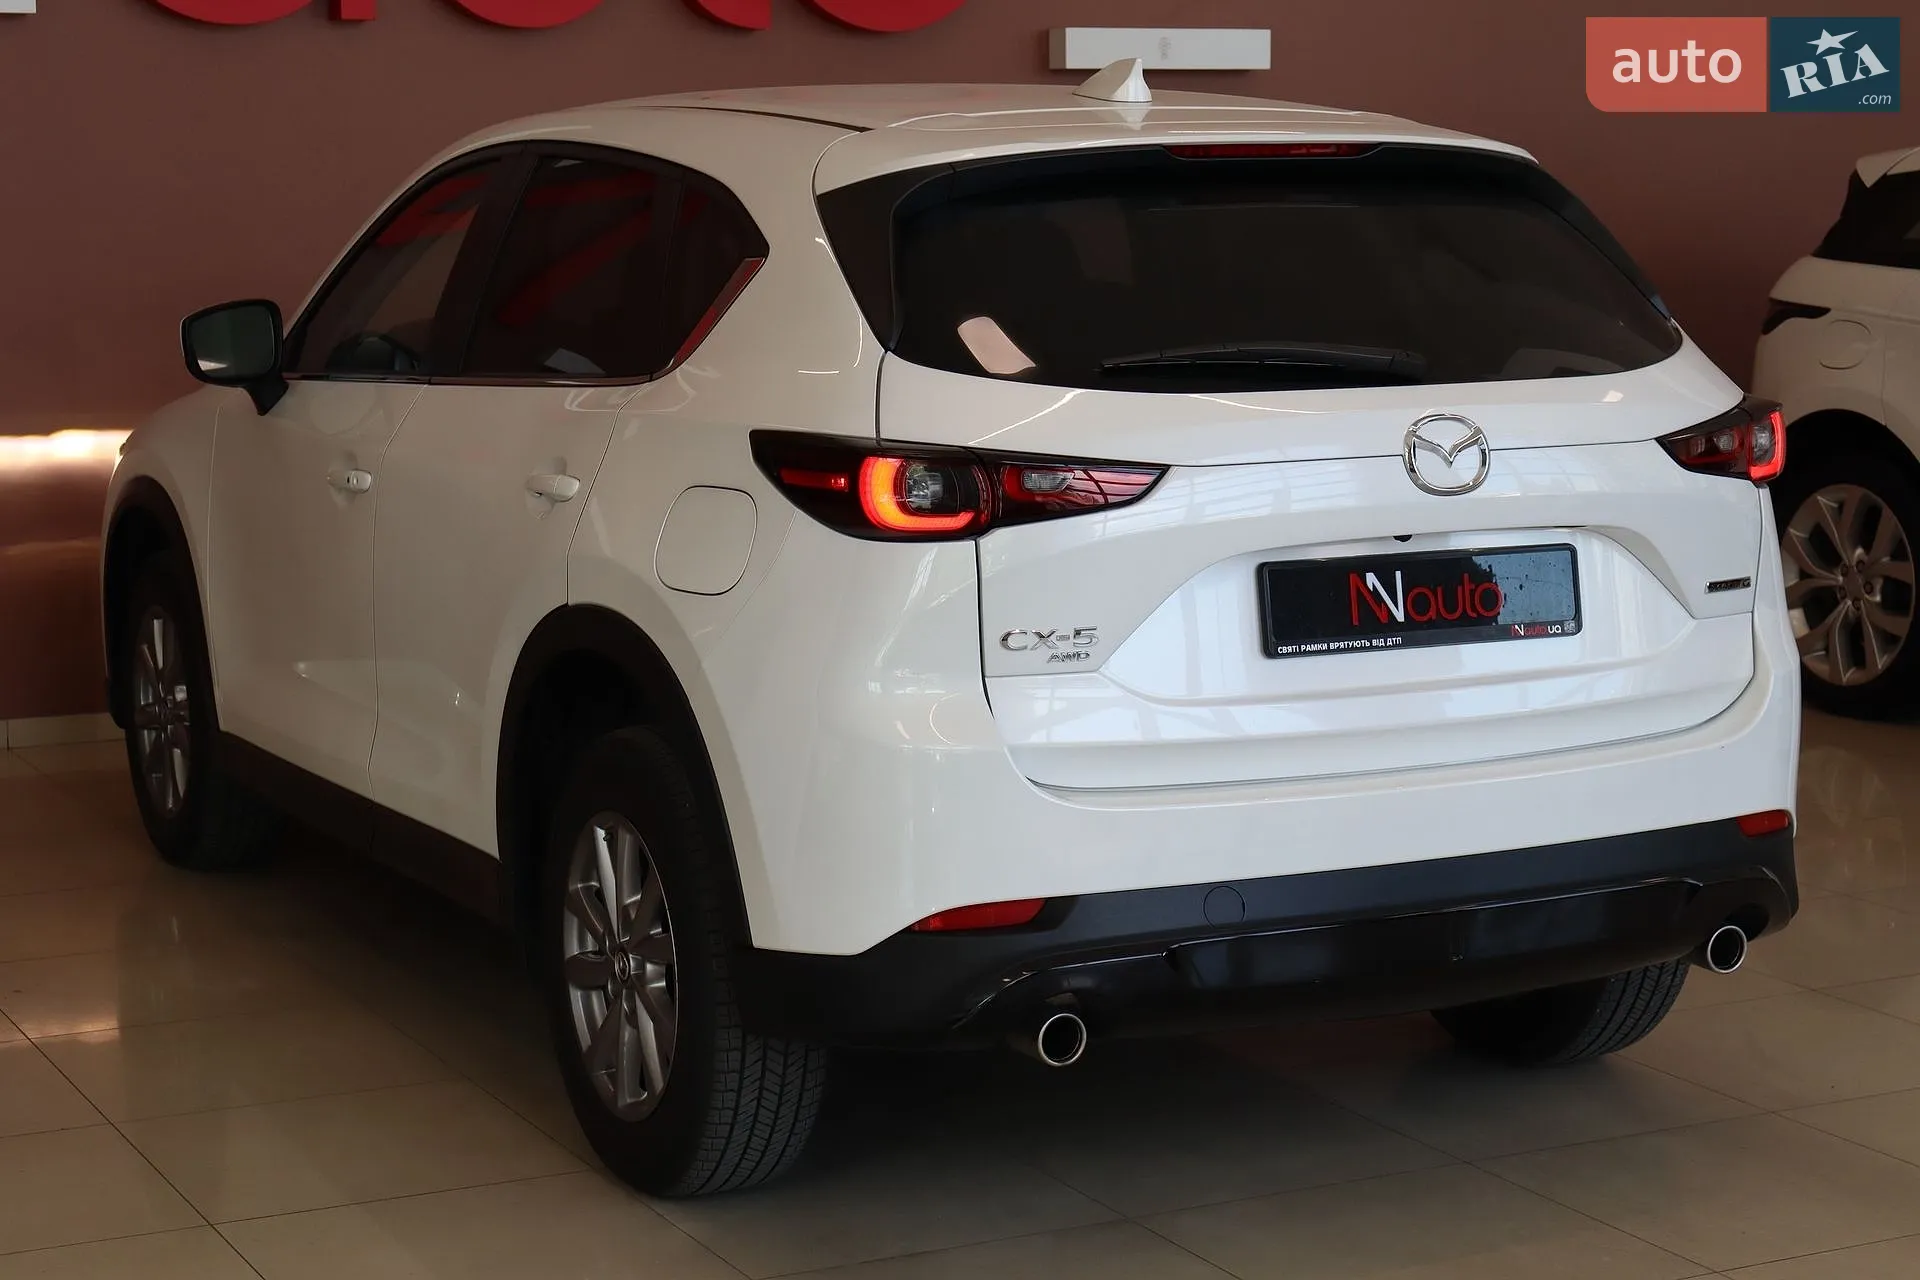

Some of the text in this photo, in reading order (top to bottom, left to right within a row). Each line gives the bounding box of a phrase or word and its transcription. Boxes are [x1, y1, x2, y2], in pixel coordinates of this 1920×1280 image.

[1000, 625, 1099, 651] CX-5
[1277, 636, 1402, 654] СВЯТІ РАМКИ ВРЯТУЮТЬ ВІД ДТП
[1046, 650, 1090, 663] AWD
